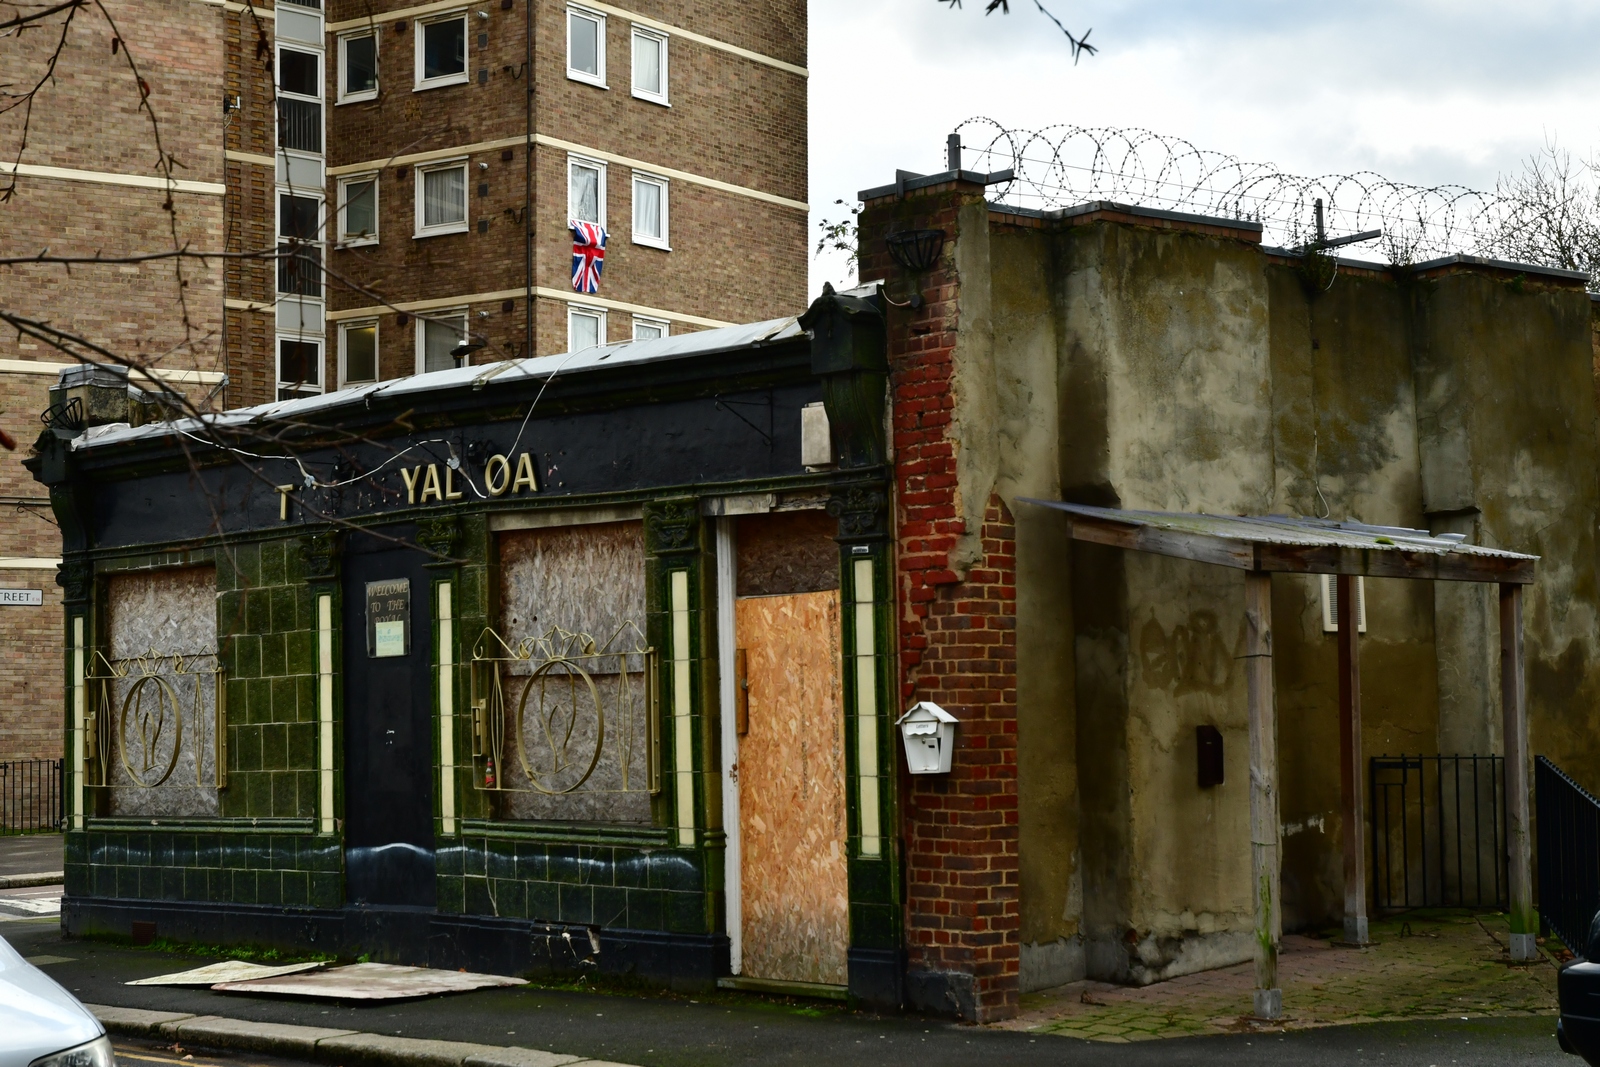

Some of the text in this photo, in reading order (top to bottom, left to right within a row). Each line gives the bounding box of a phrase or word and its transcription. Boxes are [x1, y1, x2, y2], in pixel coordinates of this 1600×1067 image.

[368, 582, 408, 597] WELCOME
[370, 599, 404, 612] TO THE
